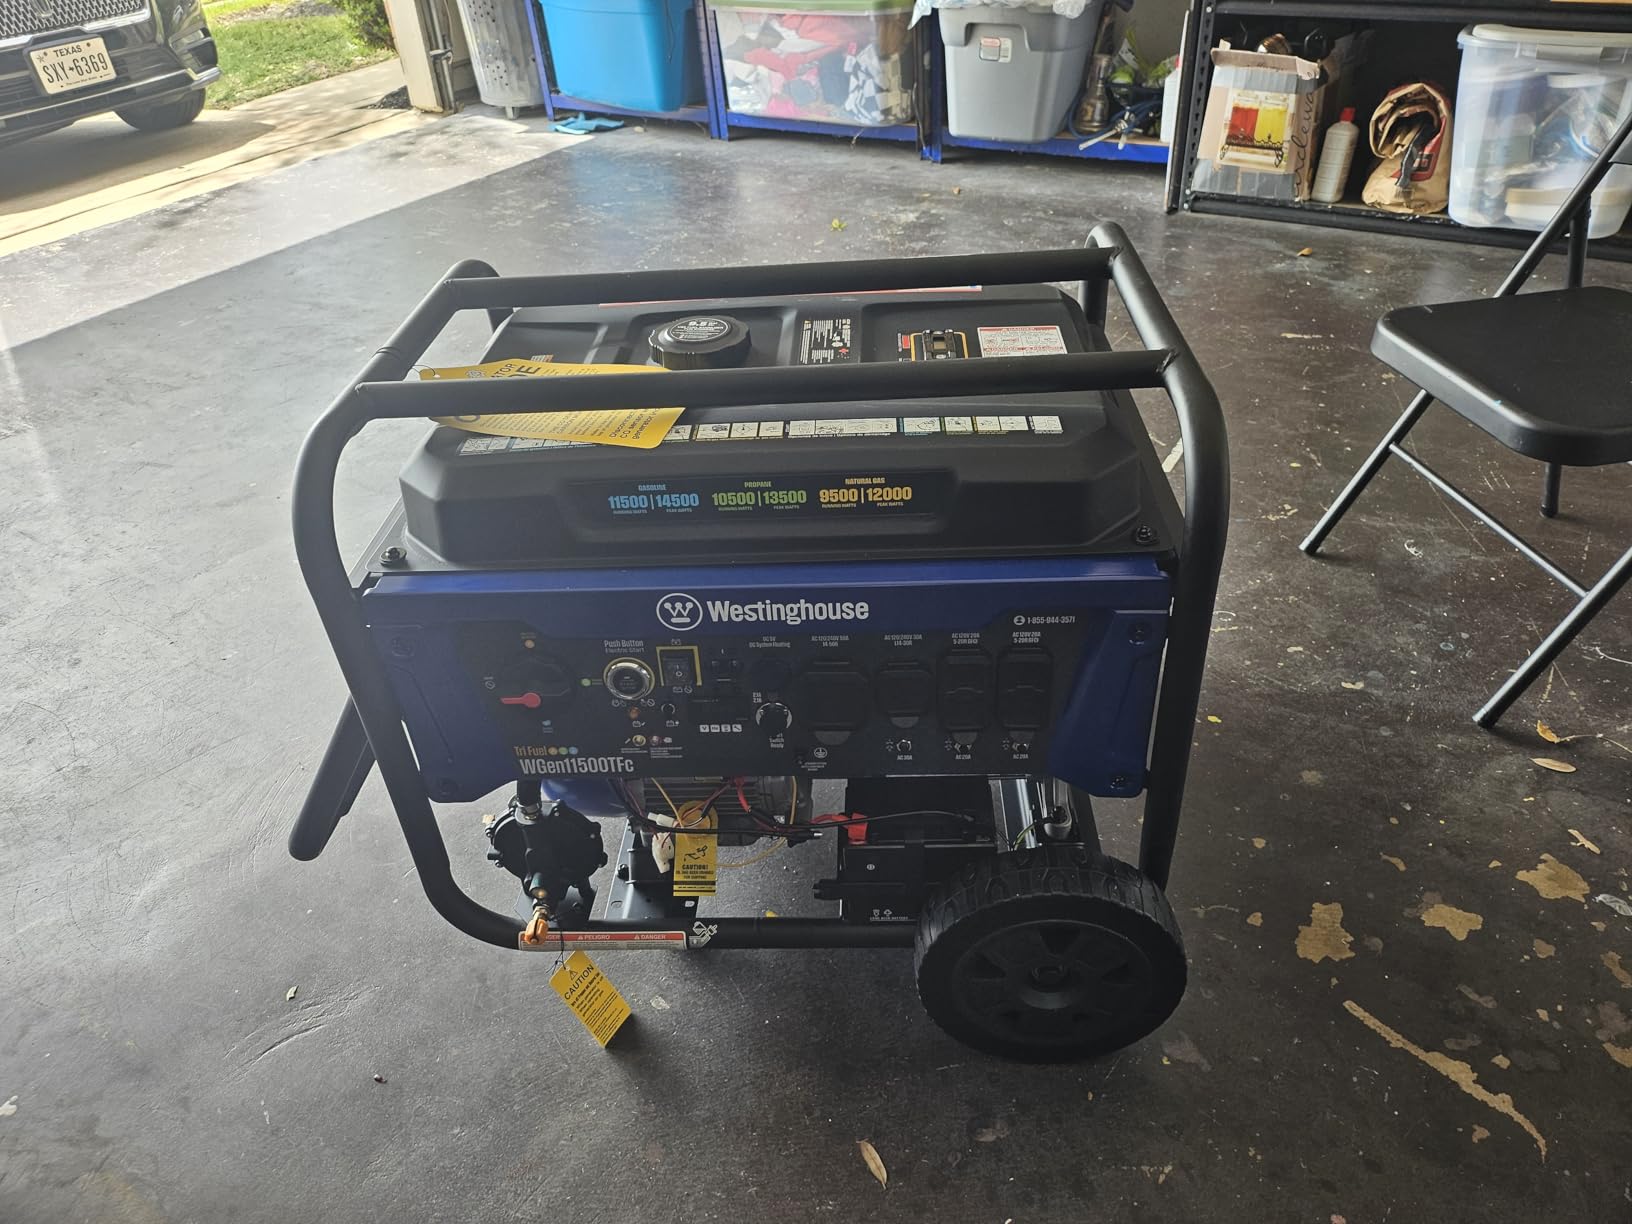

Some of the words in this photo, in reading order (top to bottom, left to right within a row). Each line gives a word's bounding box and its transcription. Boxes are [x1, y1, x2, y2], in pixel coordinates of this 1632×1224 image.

[53, 45, 82, 57] TEXAS
[638, 484, 667, 492] GASOLINE
[819, 488, 858, 503] 9500
[866, 486, 912, 501] 12000
[608, 495, 649, 509] 11500
[655, 493, 700, 508] 14500
[712, 492, 756, 506] 10500
[763, 490, 807, 504] 13500
[706, 599, 869, 625] Westinghouse
[1027, 616, 1076, 624] 1-855-944-3571
[604, 639, 621, 648] Push
[621, 639, 644, 648] Button
[513, 746, 527, 756] Tri
[527, 745, 548, 756] Fuel
[519, 757, 634, 774] WGen11500TFc
[564, 964, 594, 1000] CAUTION
